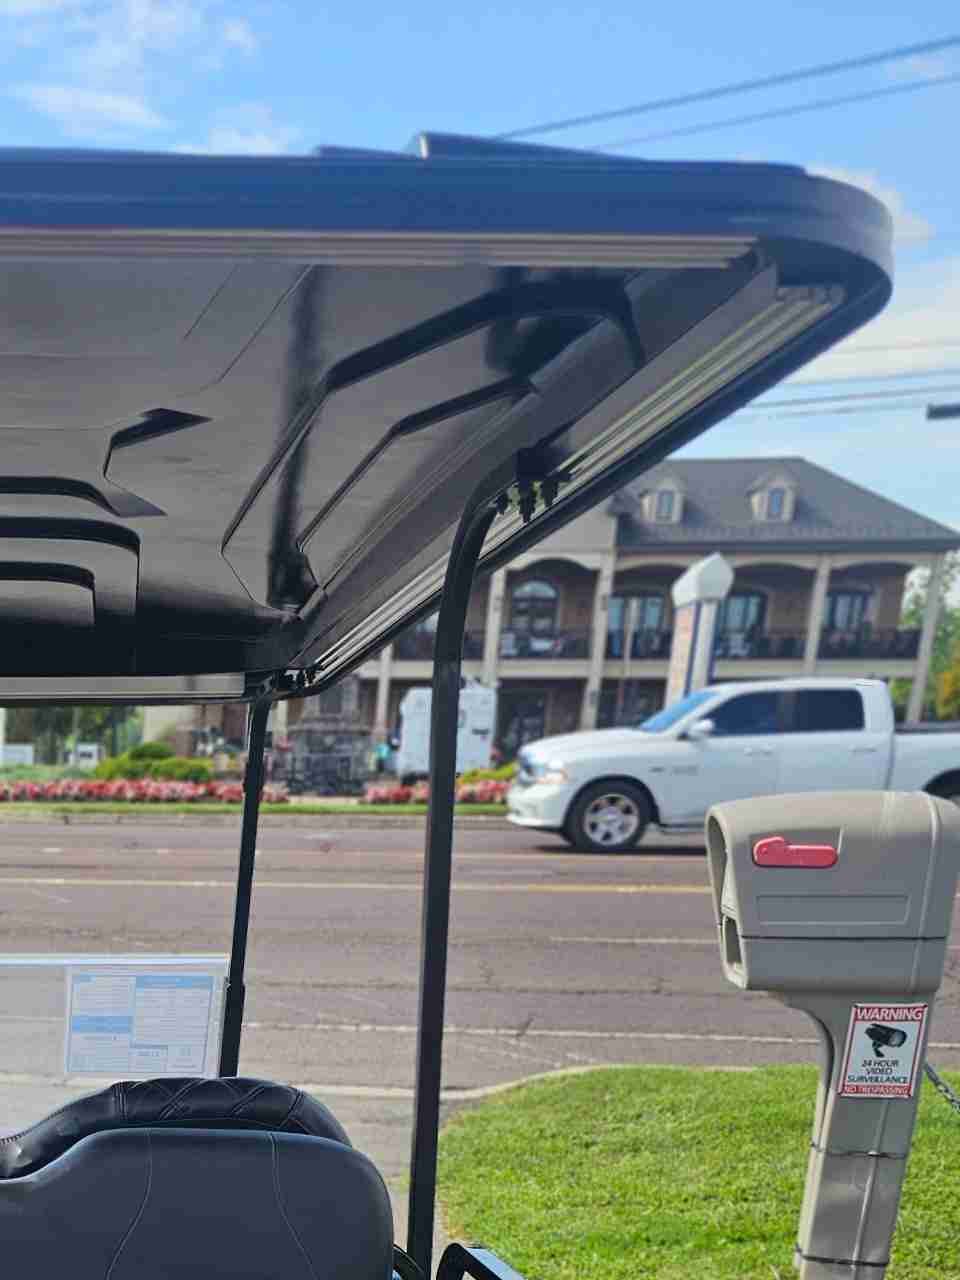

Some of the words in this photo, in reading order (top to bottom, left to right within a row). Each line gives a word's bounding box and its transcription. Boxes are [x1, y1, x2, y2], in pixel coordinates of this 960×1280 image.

[856, 1008, 923, 1020] WARNING
[873, 1059, 899, 1067] HOUR
[866, 1067, 893, 1075] VIDEO
[844, 1086, 856, 1094] NO
